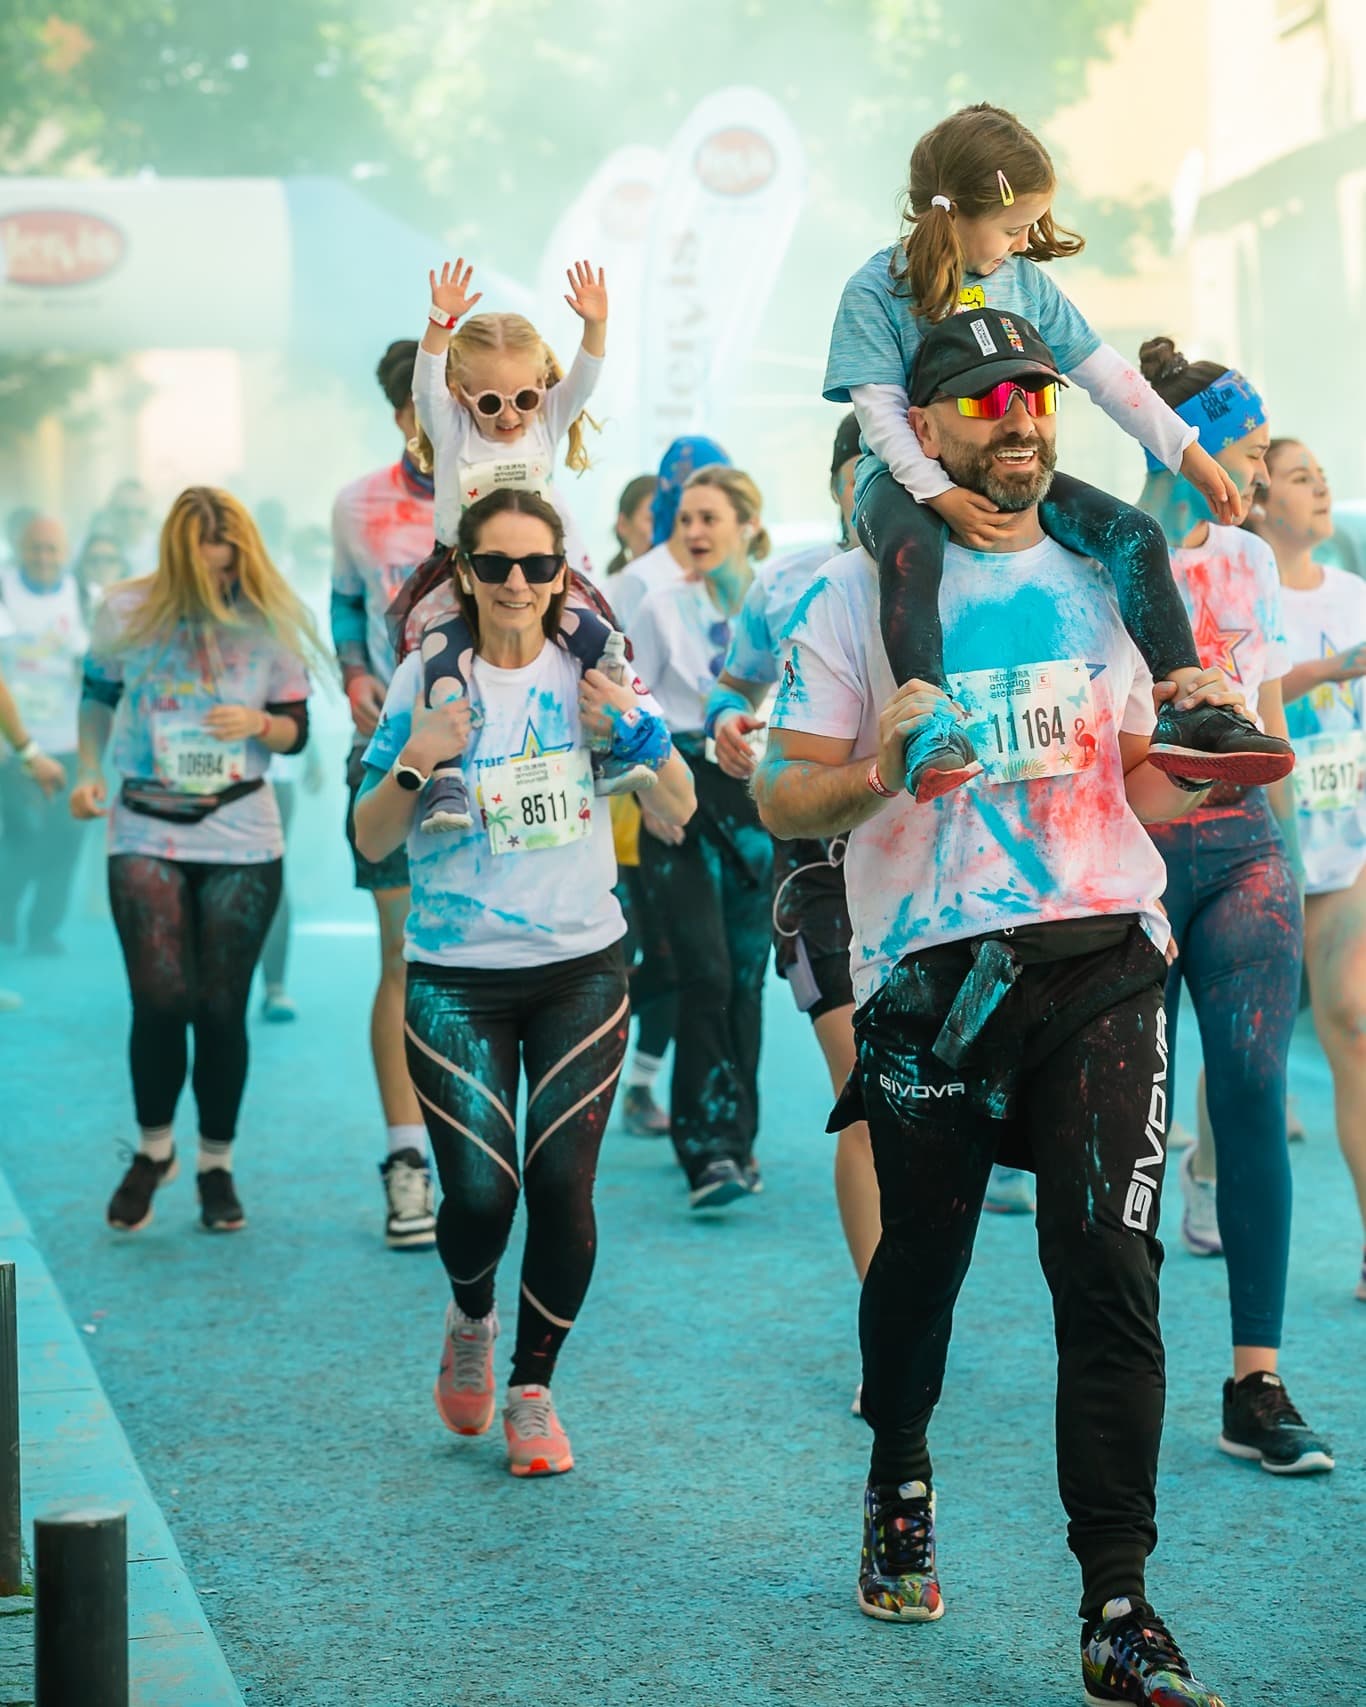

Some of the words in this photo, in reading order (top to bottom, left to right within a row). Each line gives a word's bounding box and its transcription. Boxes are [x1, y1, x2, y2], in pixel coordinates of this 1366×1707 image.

[989, 679, 1031, 690] amazing
[1311, 763, 1355, 791] 12517
[521, 790, 567, 825] 8511
[879, 1073, 965, 1098] GIVOVA
[1122, 1007, 1168, 1231] GIVOVA
